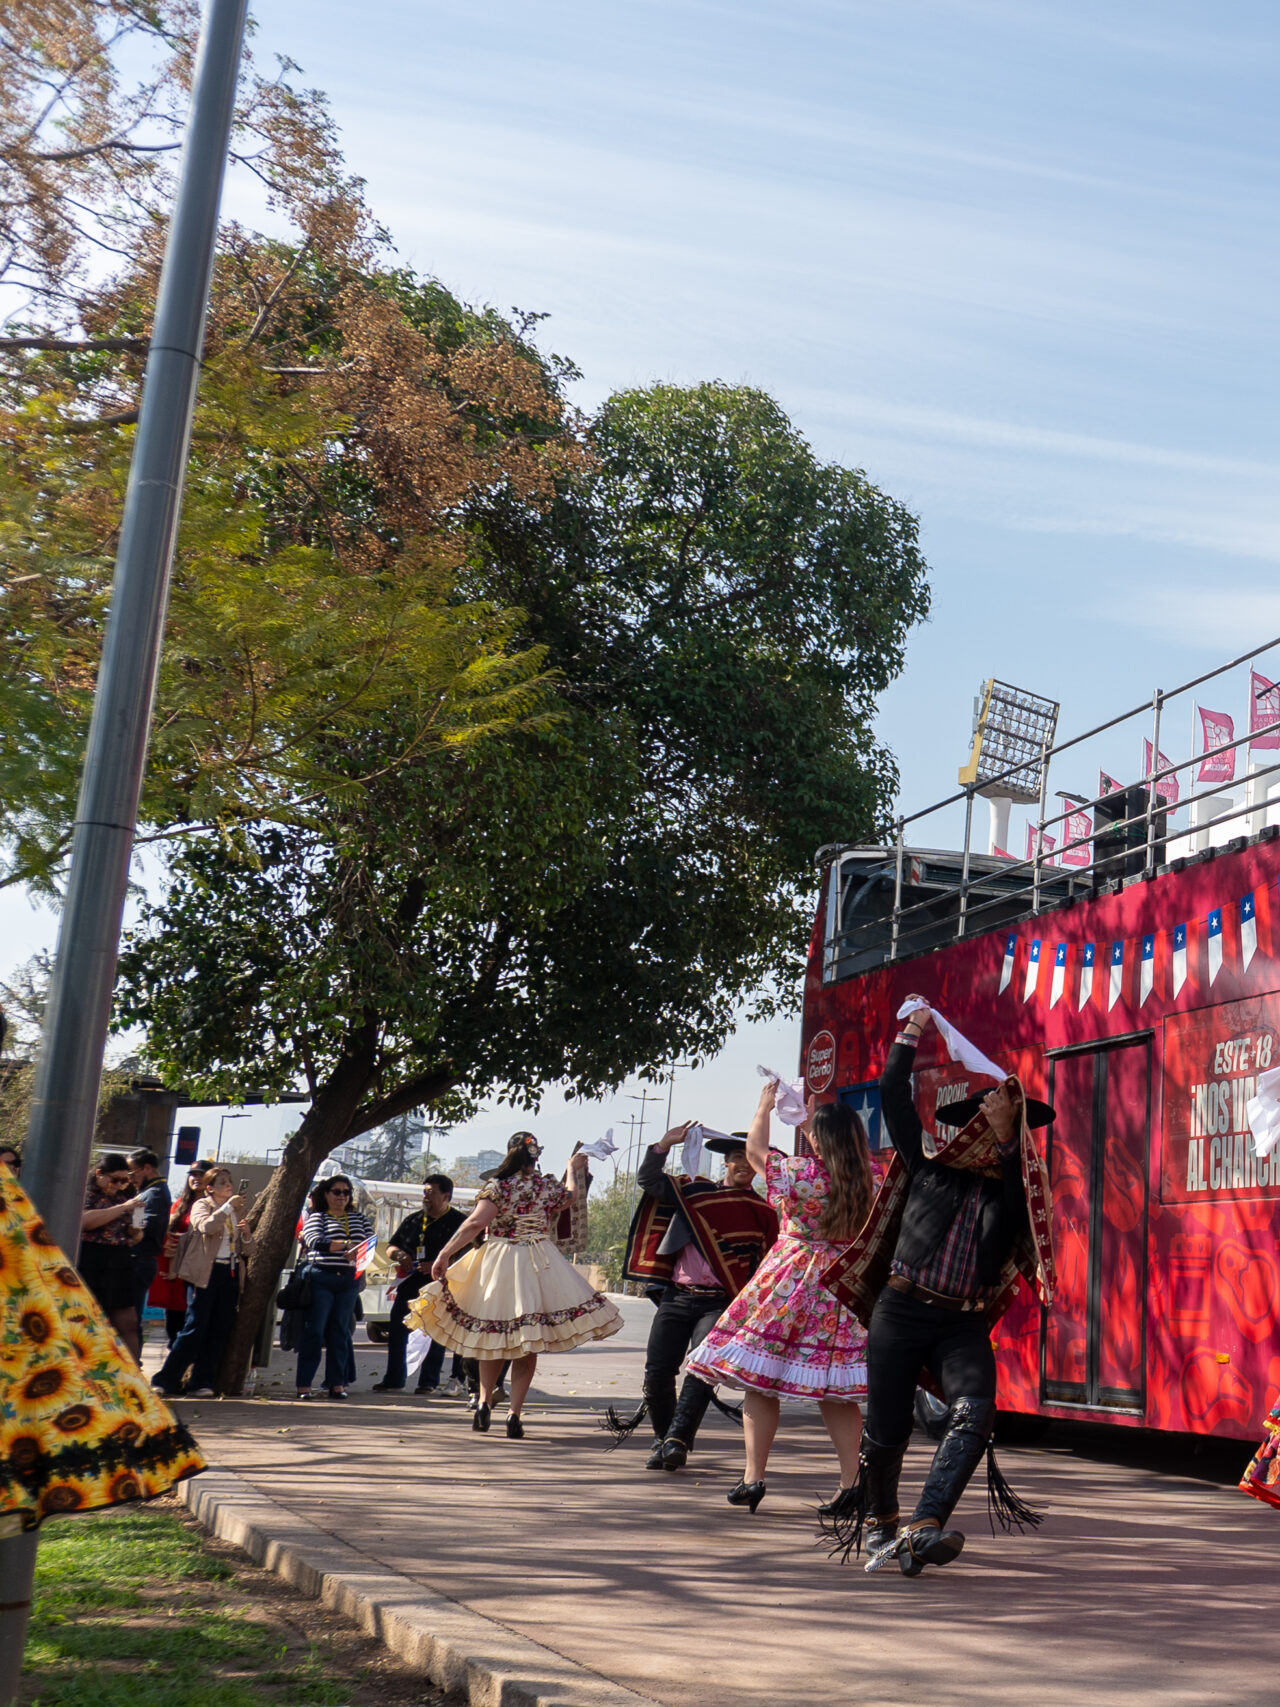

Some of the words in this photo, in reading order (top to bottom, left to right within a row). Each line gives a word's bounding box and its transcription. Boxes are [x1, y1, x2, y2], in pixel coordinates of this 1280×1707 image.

[811, 1047, 833, 1064] Super
[1214, 1037, 1250, 1075] ESTE
[1255, 1034, 1273, 1069] 18
[1190, 1080, 1230, 1138] ¡NOS
[1186, 1138, 1208, 1192] AL
